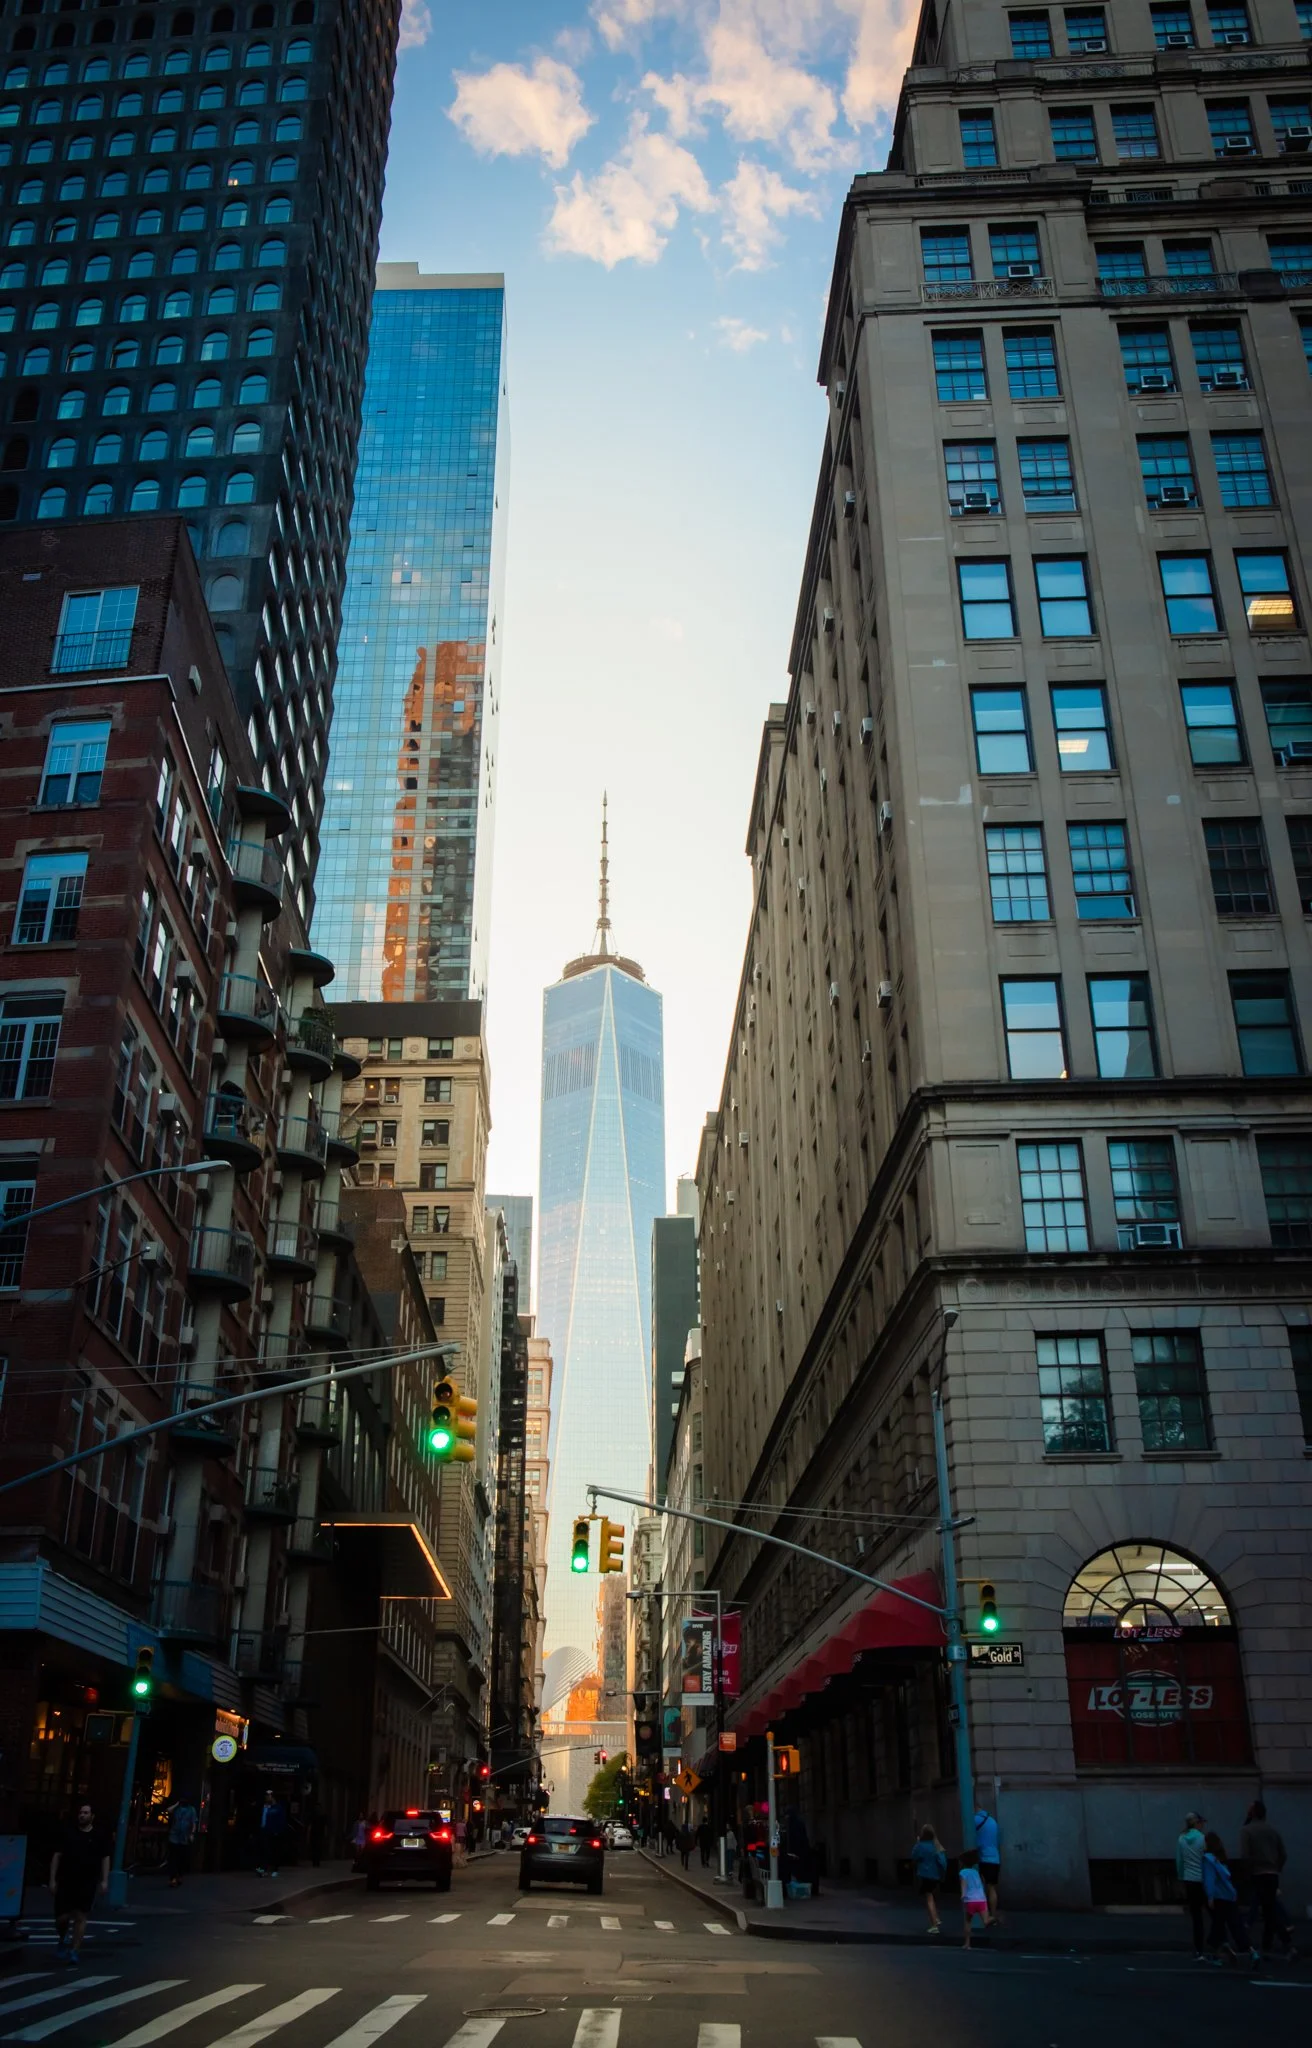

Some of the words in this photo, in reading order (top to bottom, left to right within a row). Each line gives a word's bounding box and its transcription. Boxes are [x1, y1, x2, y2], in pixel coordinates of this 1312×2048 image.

[1113, 1627, 1182, 1639] LOT-LESS
[703, 1631, 712, 1669] AMAZING
[990, 1651, 1013, 1663] Gold
[703, 1671, 712, 1692] STAY
